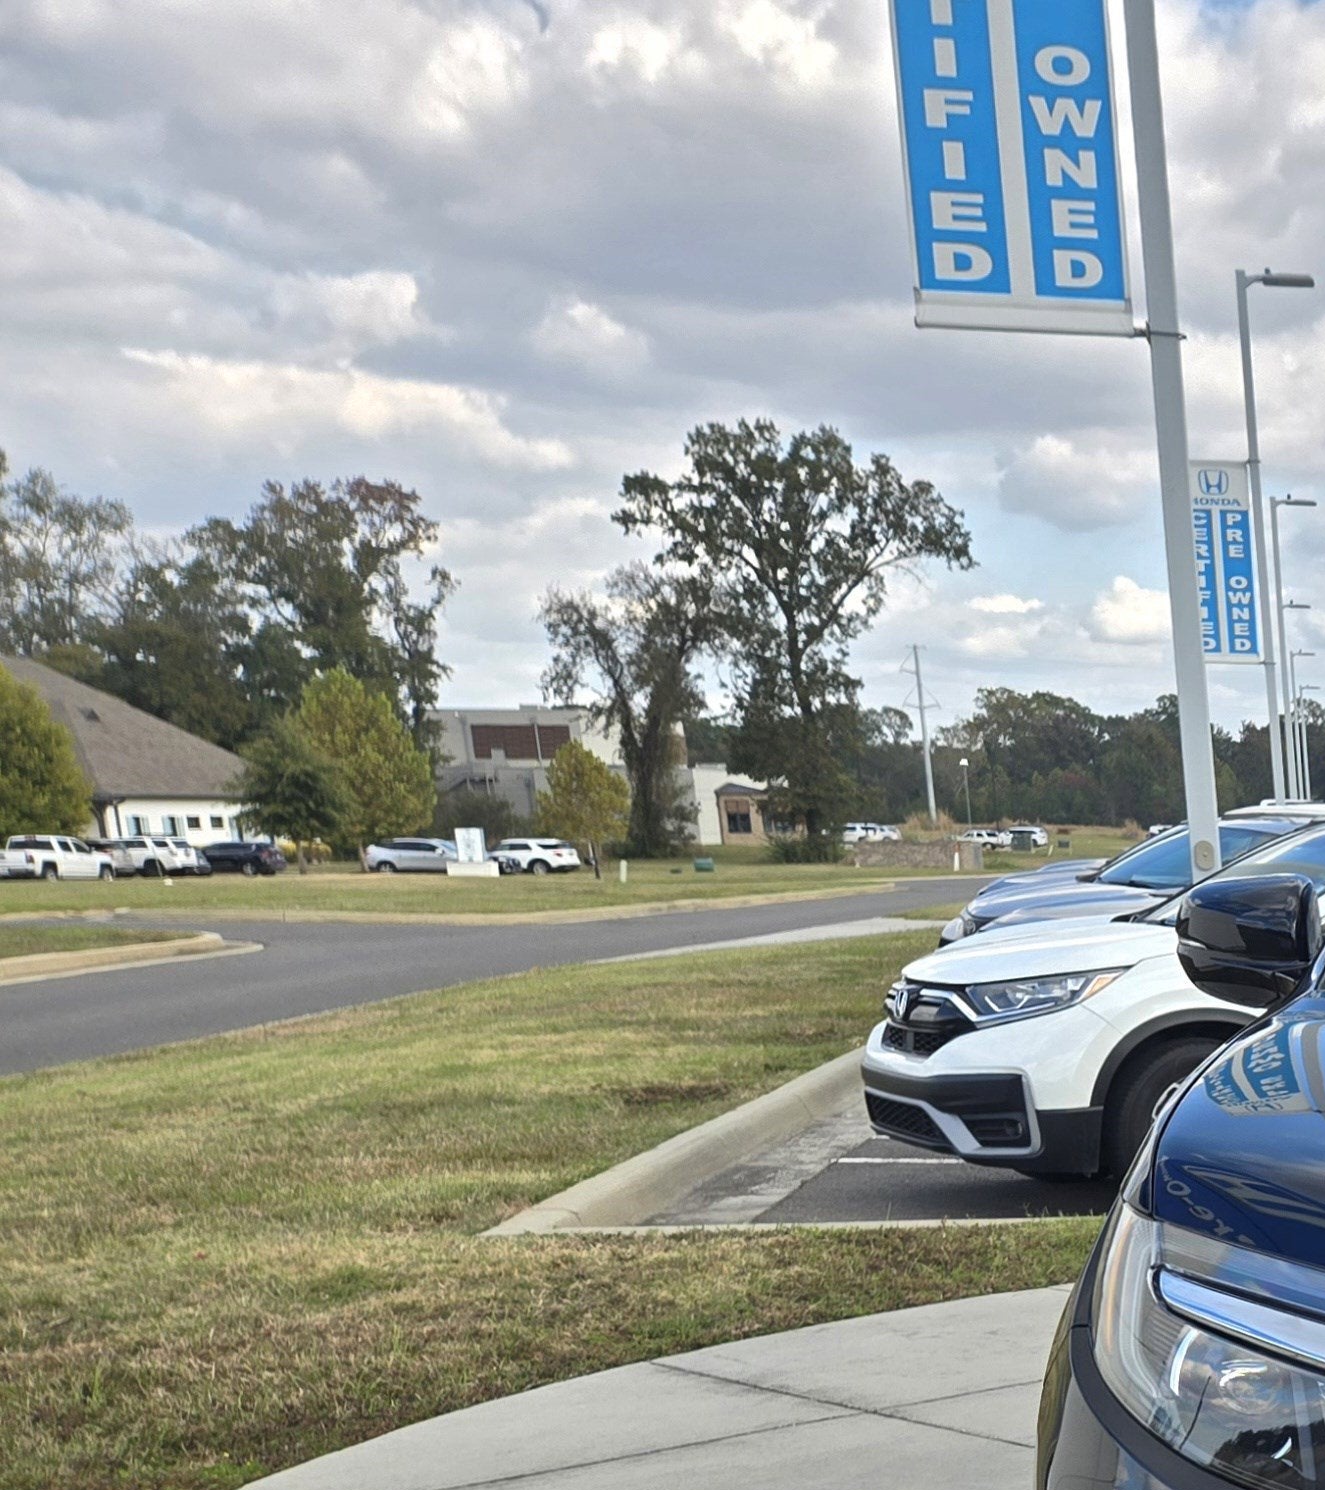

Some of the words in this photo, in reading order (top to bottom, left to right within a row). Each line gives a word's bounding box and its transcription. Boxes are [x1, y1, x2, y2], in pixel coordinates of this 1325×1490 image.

[1027, 44, 1104, 289] OWNED
[1226, 512, 1244, 559] PRE
[1228, 575, 1252, 652] OWNED
